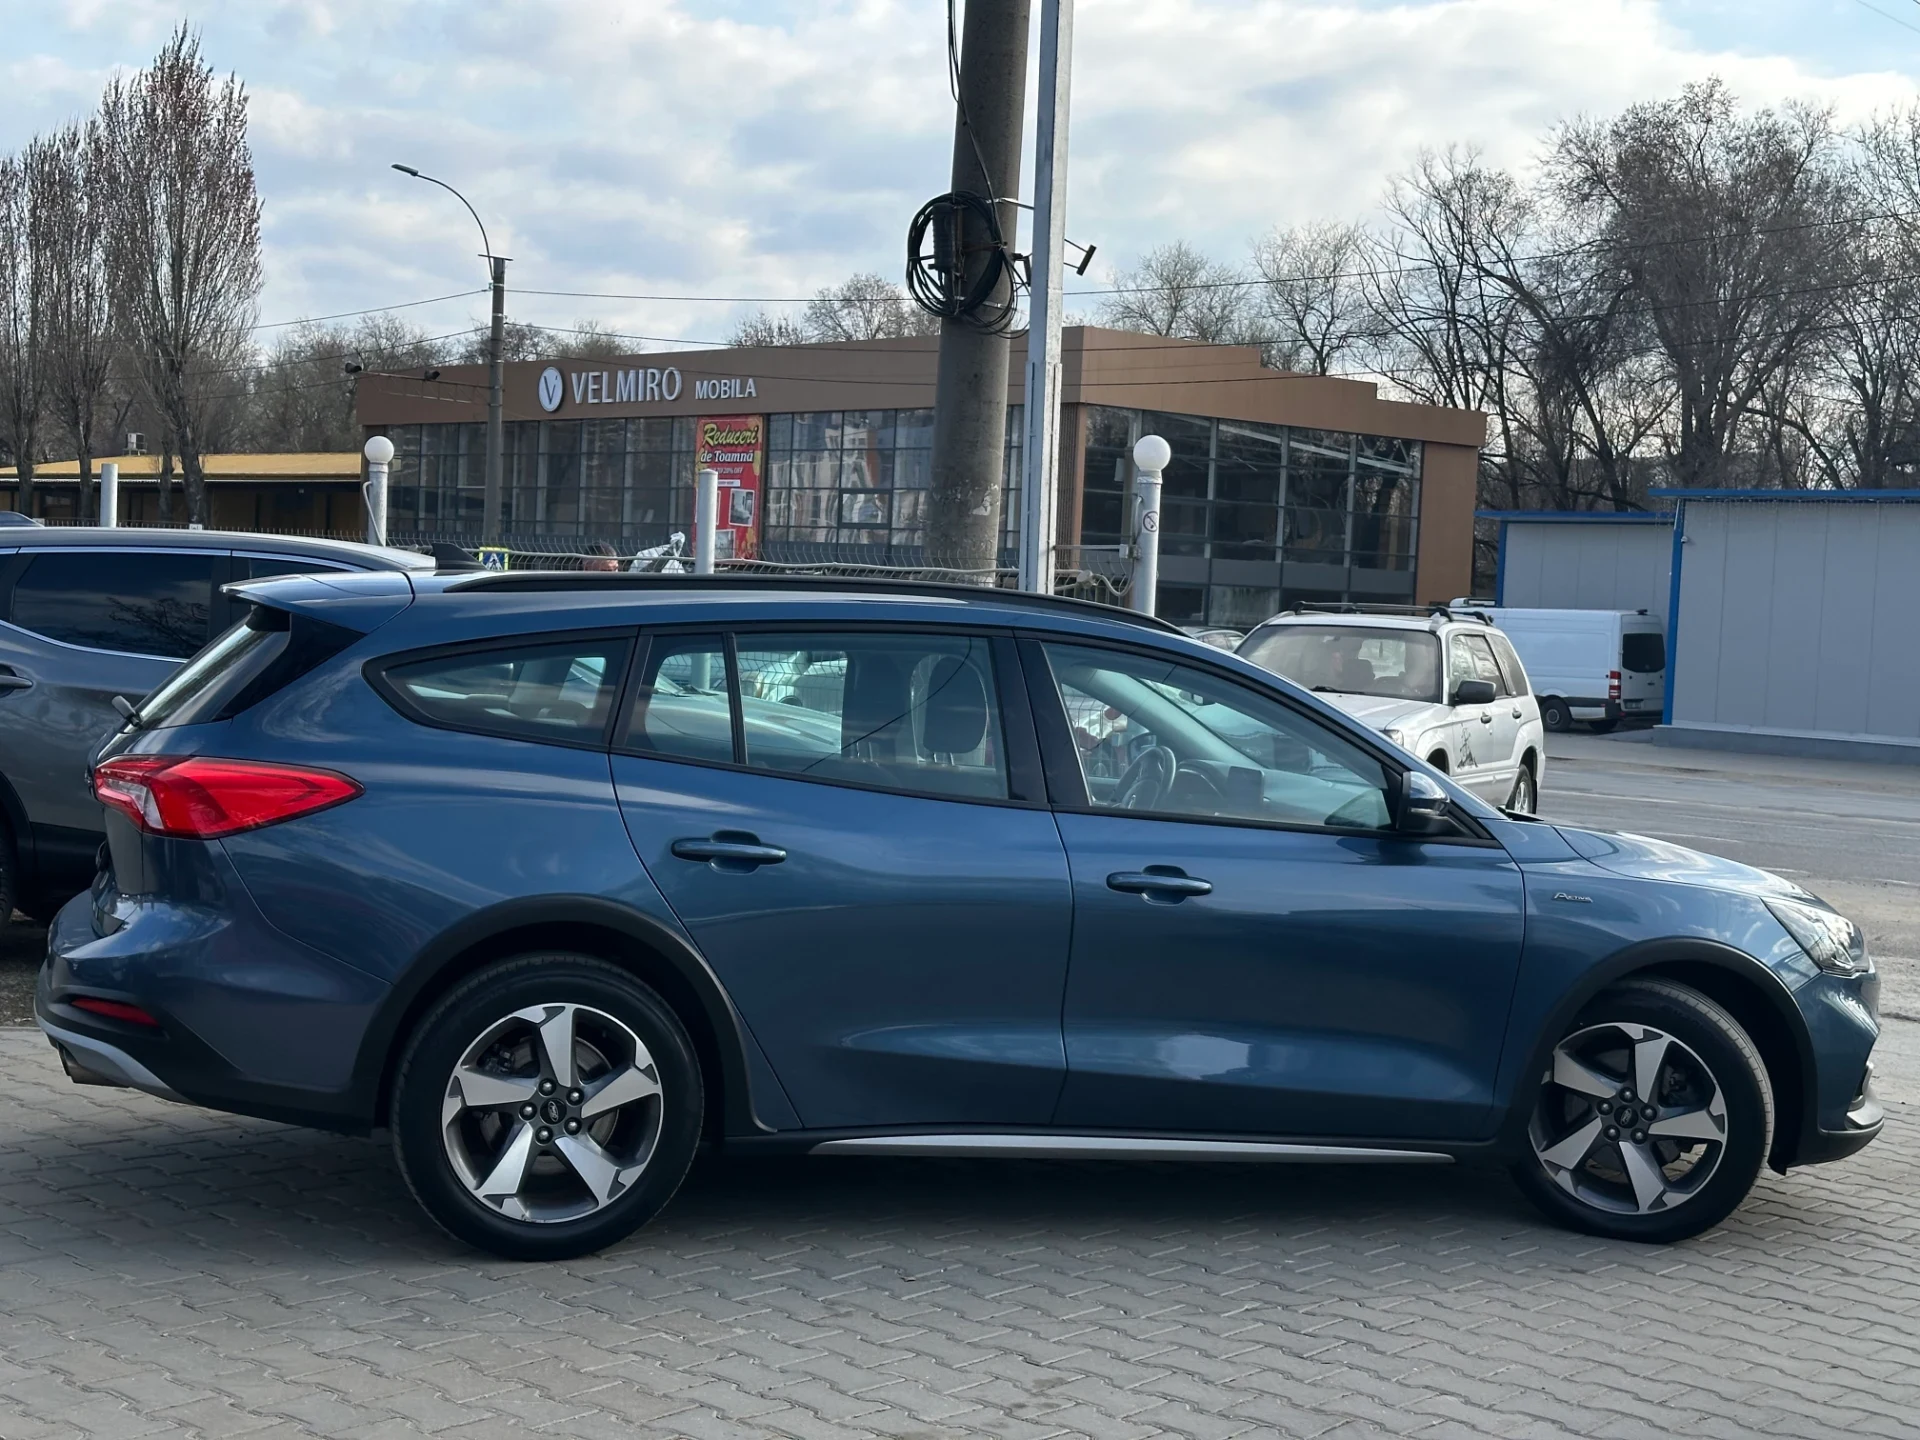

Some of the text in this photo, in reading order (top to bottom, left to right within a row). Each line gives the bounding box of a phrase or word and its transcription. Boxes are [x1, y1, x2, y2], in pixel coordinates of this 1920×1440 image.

[571, 367, 682, 404] VELMIRO
[695, 378, 758, 400] MOBILA
[702, 423, 759, 447] Reduceri
[700, 450, 713, 463] de
